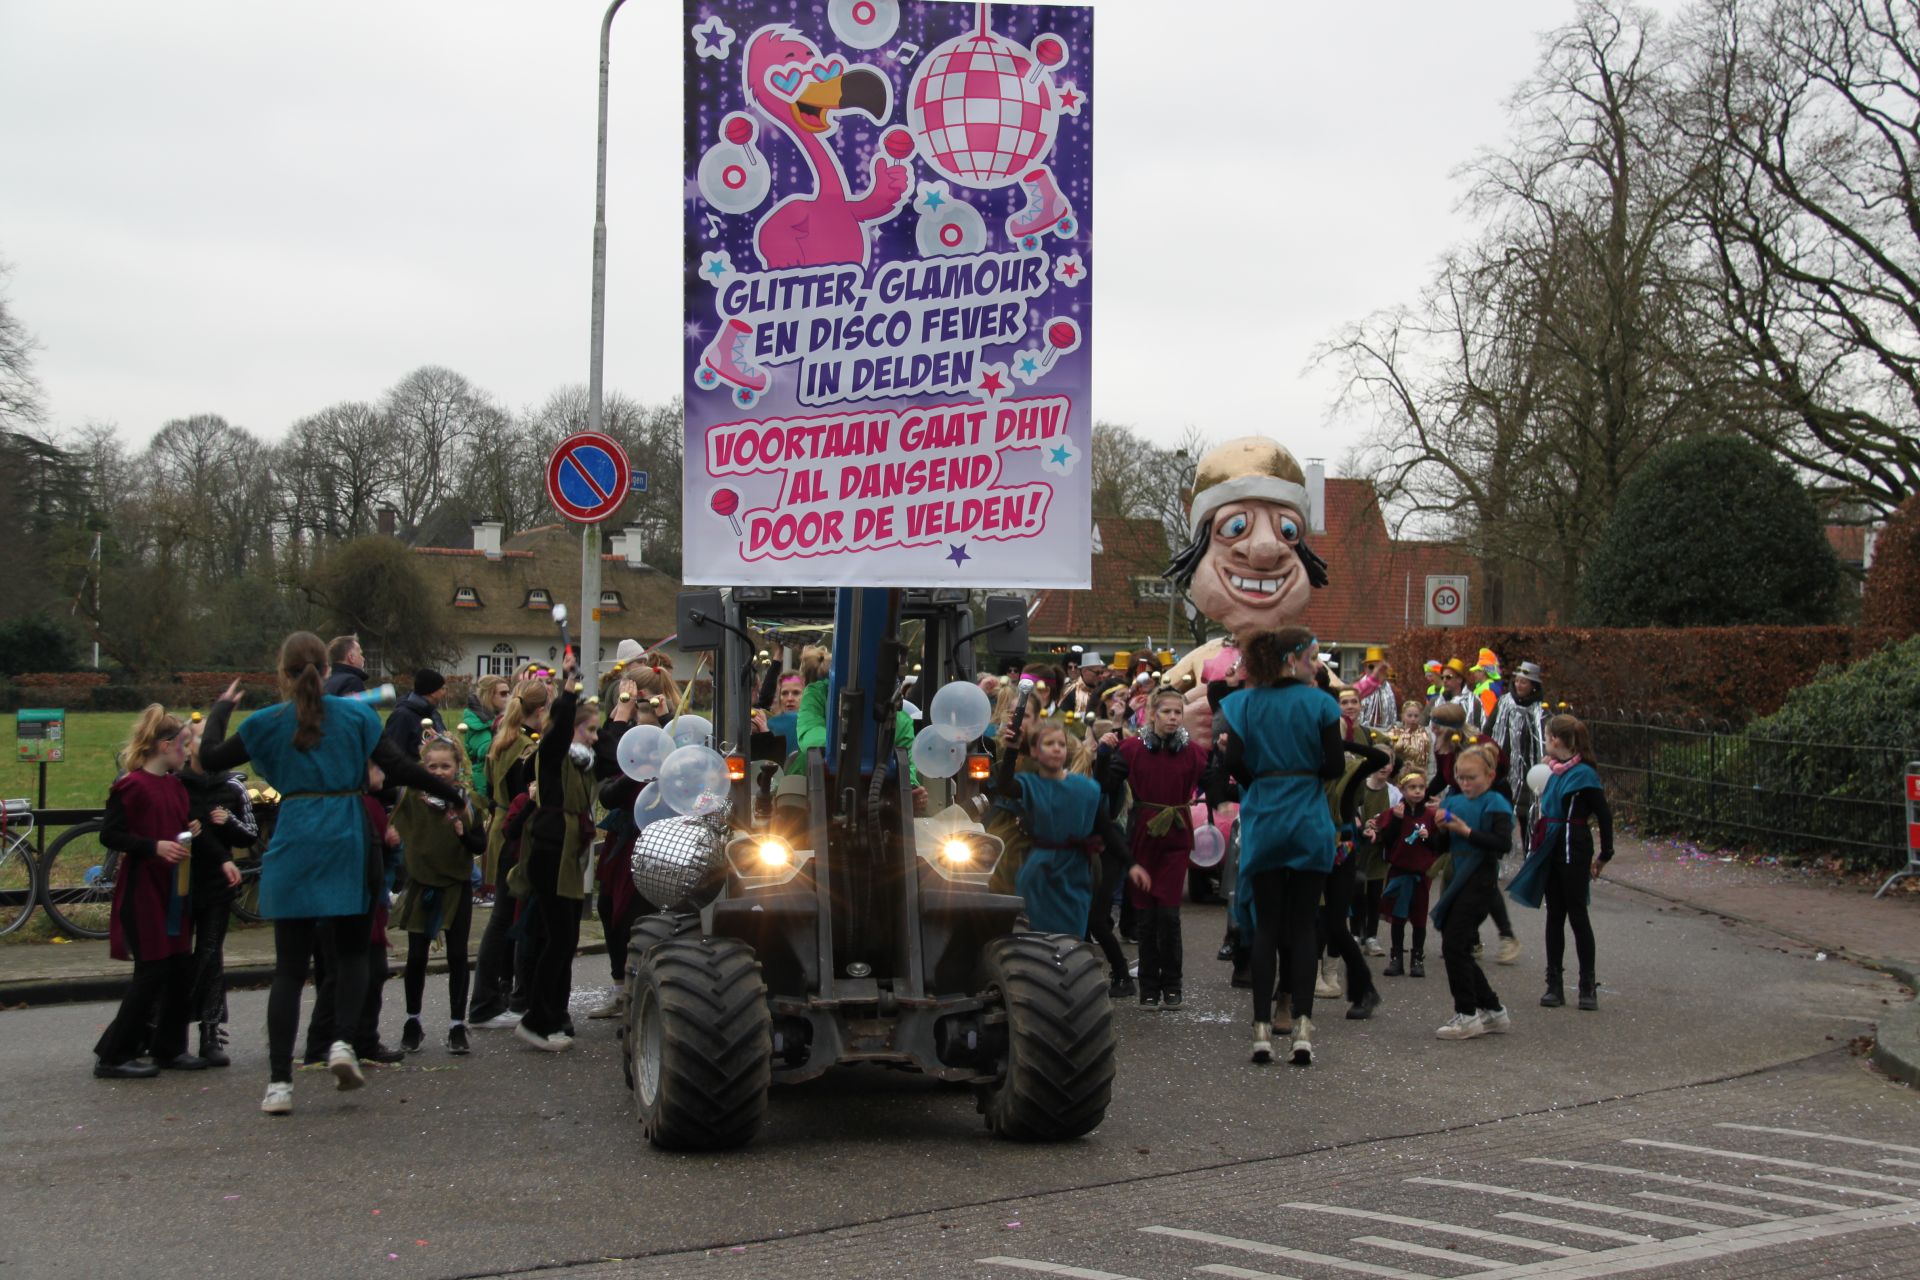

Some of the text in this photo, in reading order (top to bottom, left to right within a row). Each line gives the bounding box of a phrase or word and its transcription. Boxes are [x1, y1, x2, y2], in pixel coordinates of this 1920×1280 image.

[722, 257, 1042, 317] GLITTER, GLAMOUR
[755, 303, 1021, 358] EN DISCO FEVER
[806, 351, 974, 398] IN DELDEN
[715, 404, 1061, 467] VOORTAAN GAAT DHV
[787, 454, 993, 506] AL DANSEND
[749, 491, 1043, 552] DOOR DE VELDEN!
[1438, 595, 1455, 606] 30
